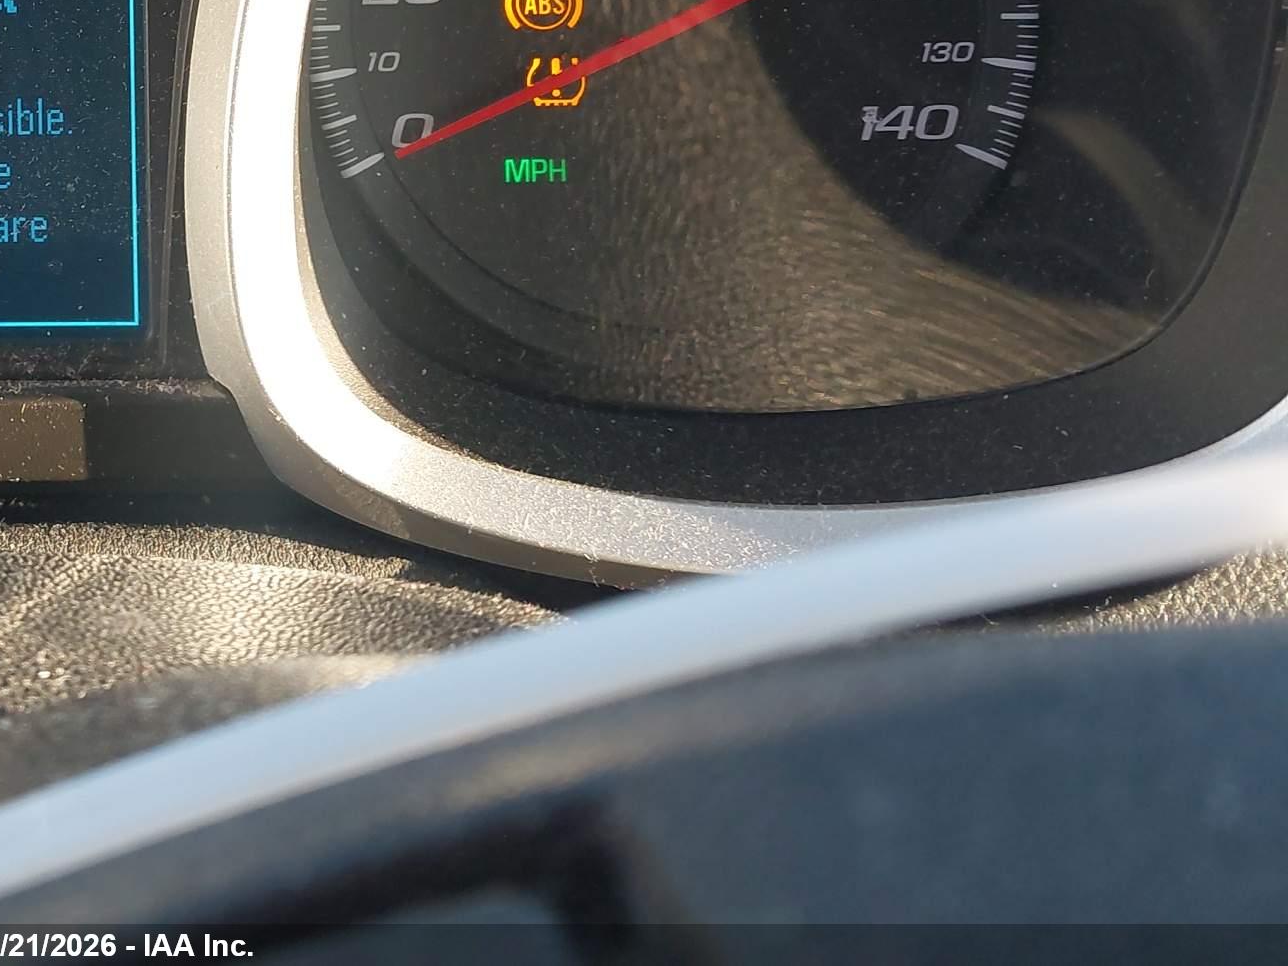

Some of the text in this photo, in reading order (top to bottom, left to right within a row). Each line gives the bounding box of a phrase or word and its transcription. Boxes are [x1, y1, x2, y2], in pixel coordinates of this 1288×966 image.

[367, 51, 401, 73] 10
[920, 41, 975, 64] 130
[392, 113, 434, 148] 0
[859, 104, 959, 141] 140
[504, 158, 567, 183] MPH
